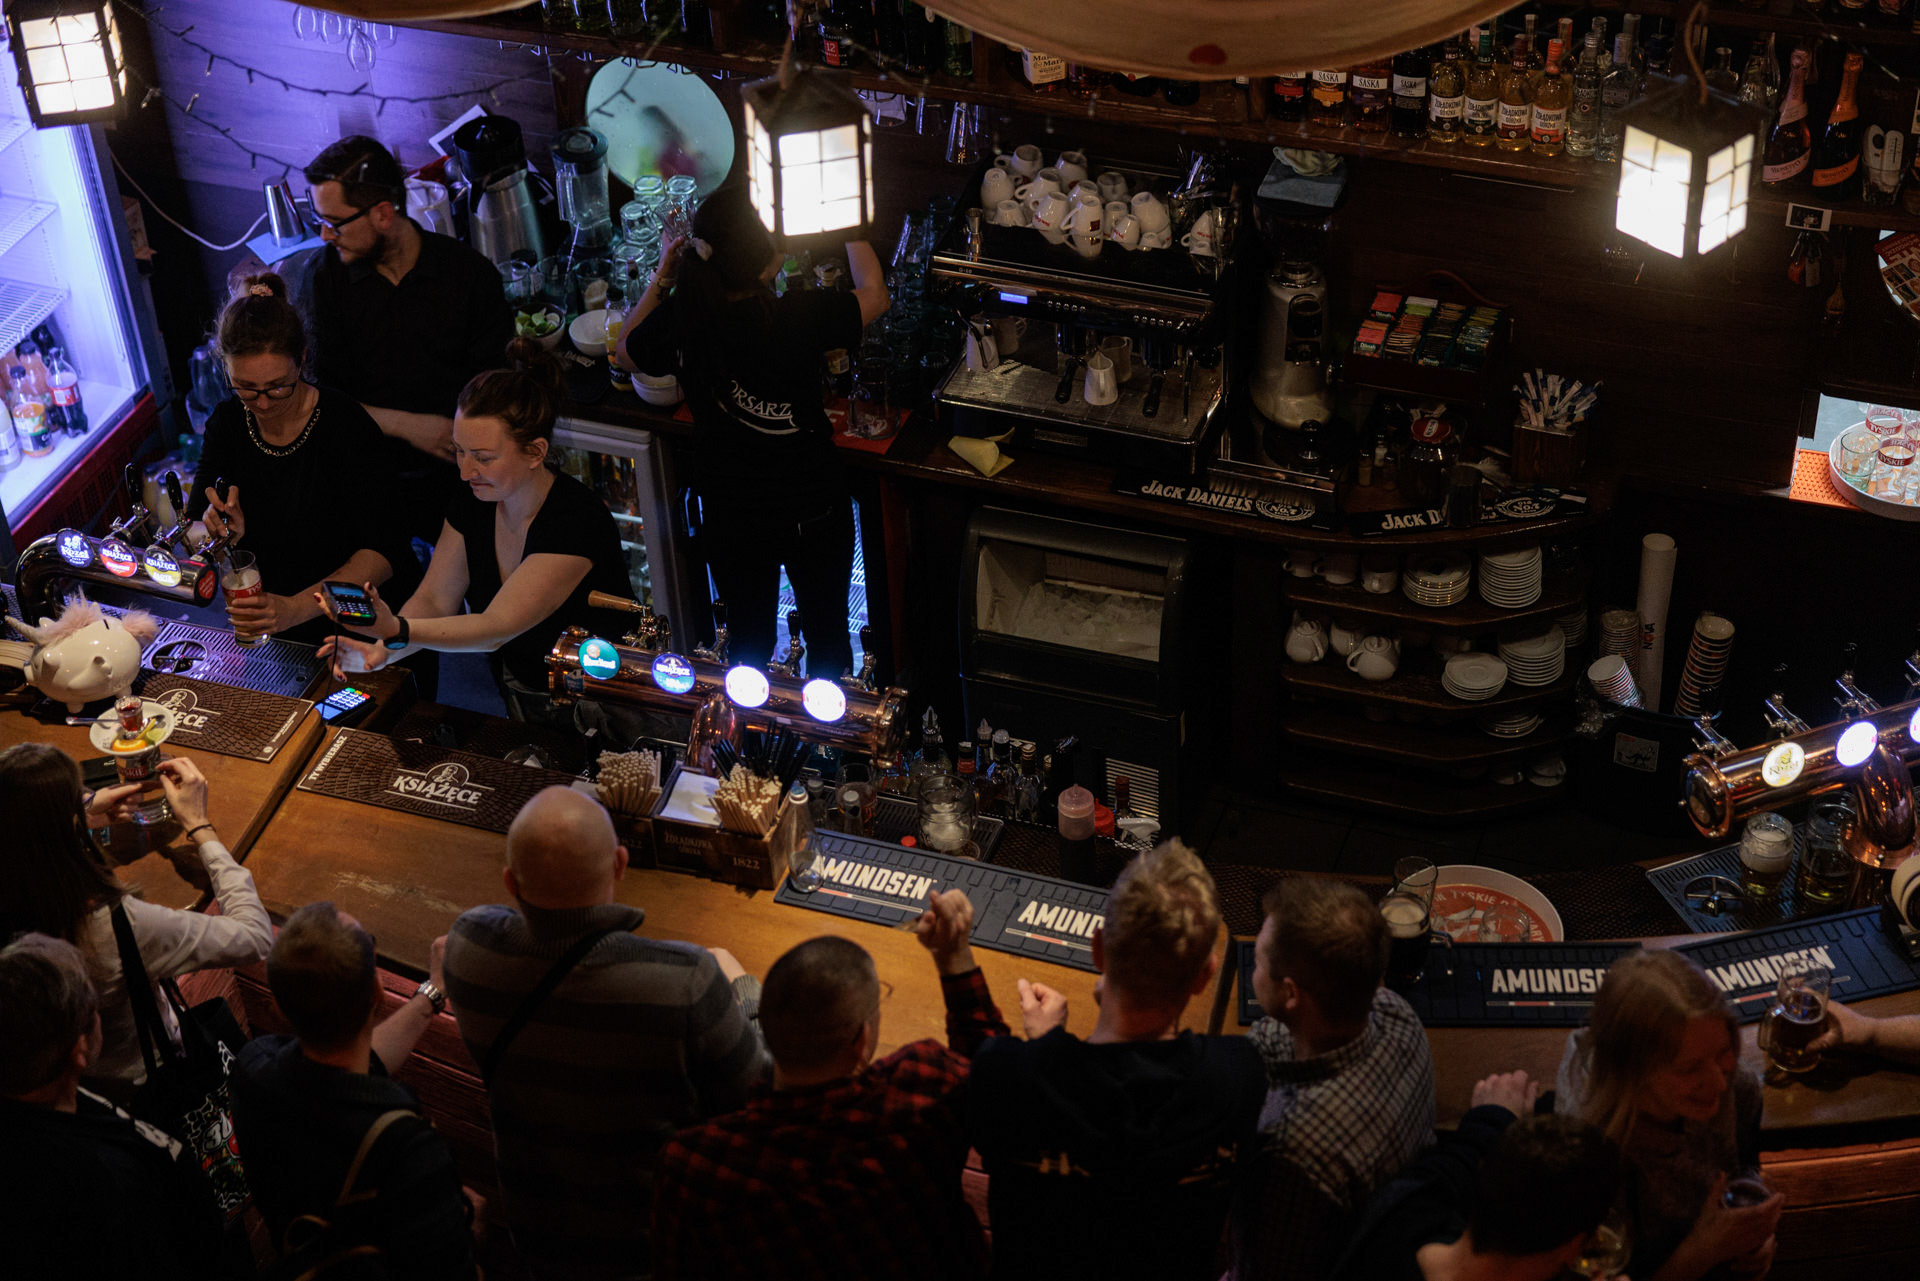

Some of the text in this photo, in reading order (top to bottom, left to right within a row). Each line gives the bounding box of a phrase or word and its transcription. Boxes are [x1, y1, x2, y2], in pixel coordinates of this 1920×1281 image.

[1318, 72, 1339, 83] SASKA
[1359, 81, 1380, 89] SASKA
[1401, 79, 1417, 89] SASKA
[1880, 455, 1905, 466] TYSKIE
[1141, 480, 1187, 500] JACK
[1381, 513, 1425, 531] JACK
[61, 545, 90, 559] Kozel
[308, 735, 348, 781] TY WYBIERASZ
[393, 775, 483, 804] KSIĄŻĘCE
[731, 857, 761, 870] 1822
[811, 855, 932, 900] AMUNDSEN
[1017, 900, 1106, 939] AMUND
